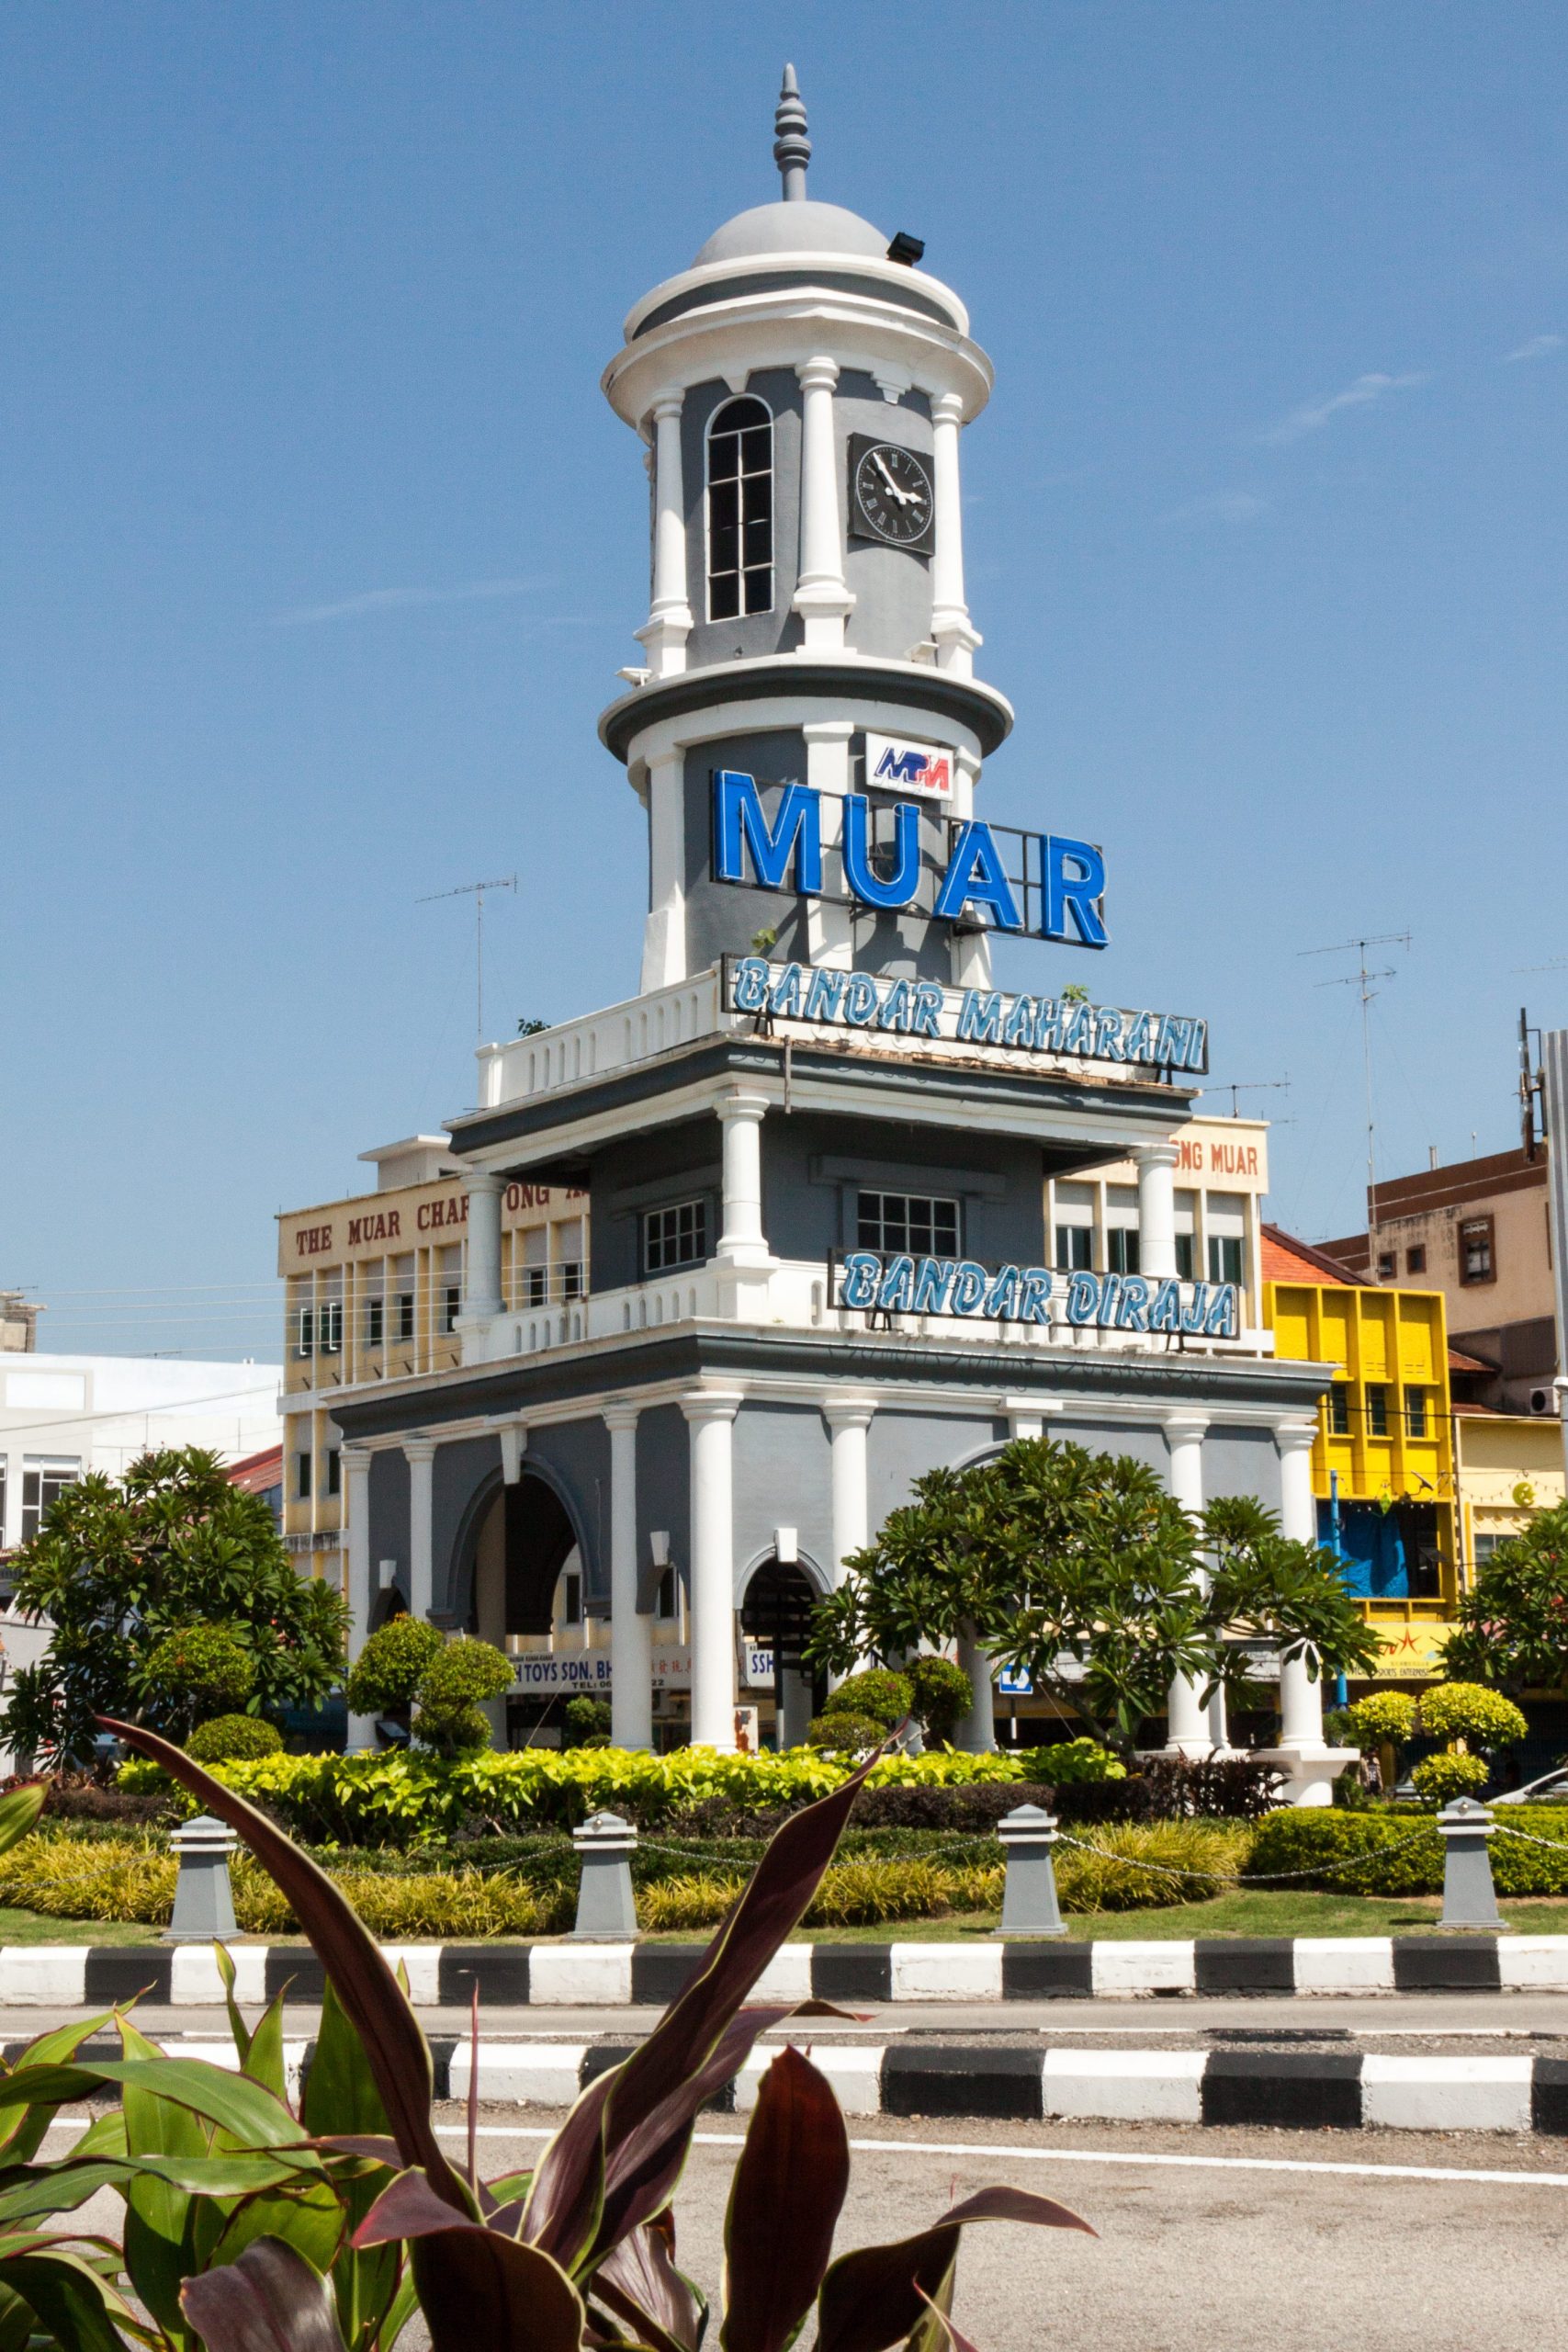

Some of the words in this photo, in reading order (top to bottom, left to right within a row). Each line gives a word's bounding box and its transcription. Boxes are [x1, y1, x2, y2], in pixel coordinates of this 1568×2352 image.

[715, 769, 1110, 949] MUAR
[735, 956, 945, 1038] BANDAR
[957, 989, 1208, 1069] MAHARANI
[1211, 1143, 1258, 1176] MUAR
[296, 1224, 333, 1257] THE
[348, 1210, 400, 1246] MUAR
[841, 1252, 1053, 1326] BANDAR
[1066, 1271, 1236, 1337] DIRAJA
[525, 1663, 558, 1683] TOYS
[562, 1661, 592, 1681] SDN.
